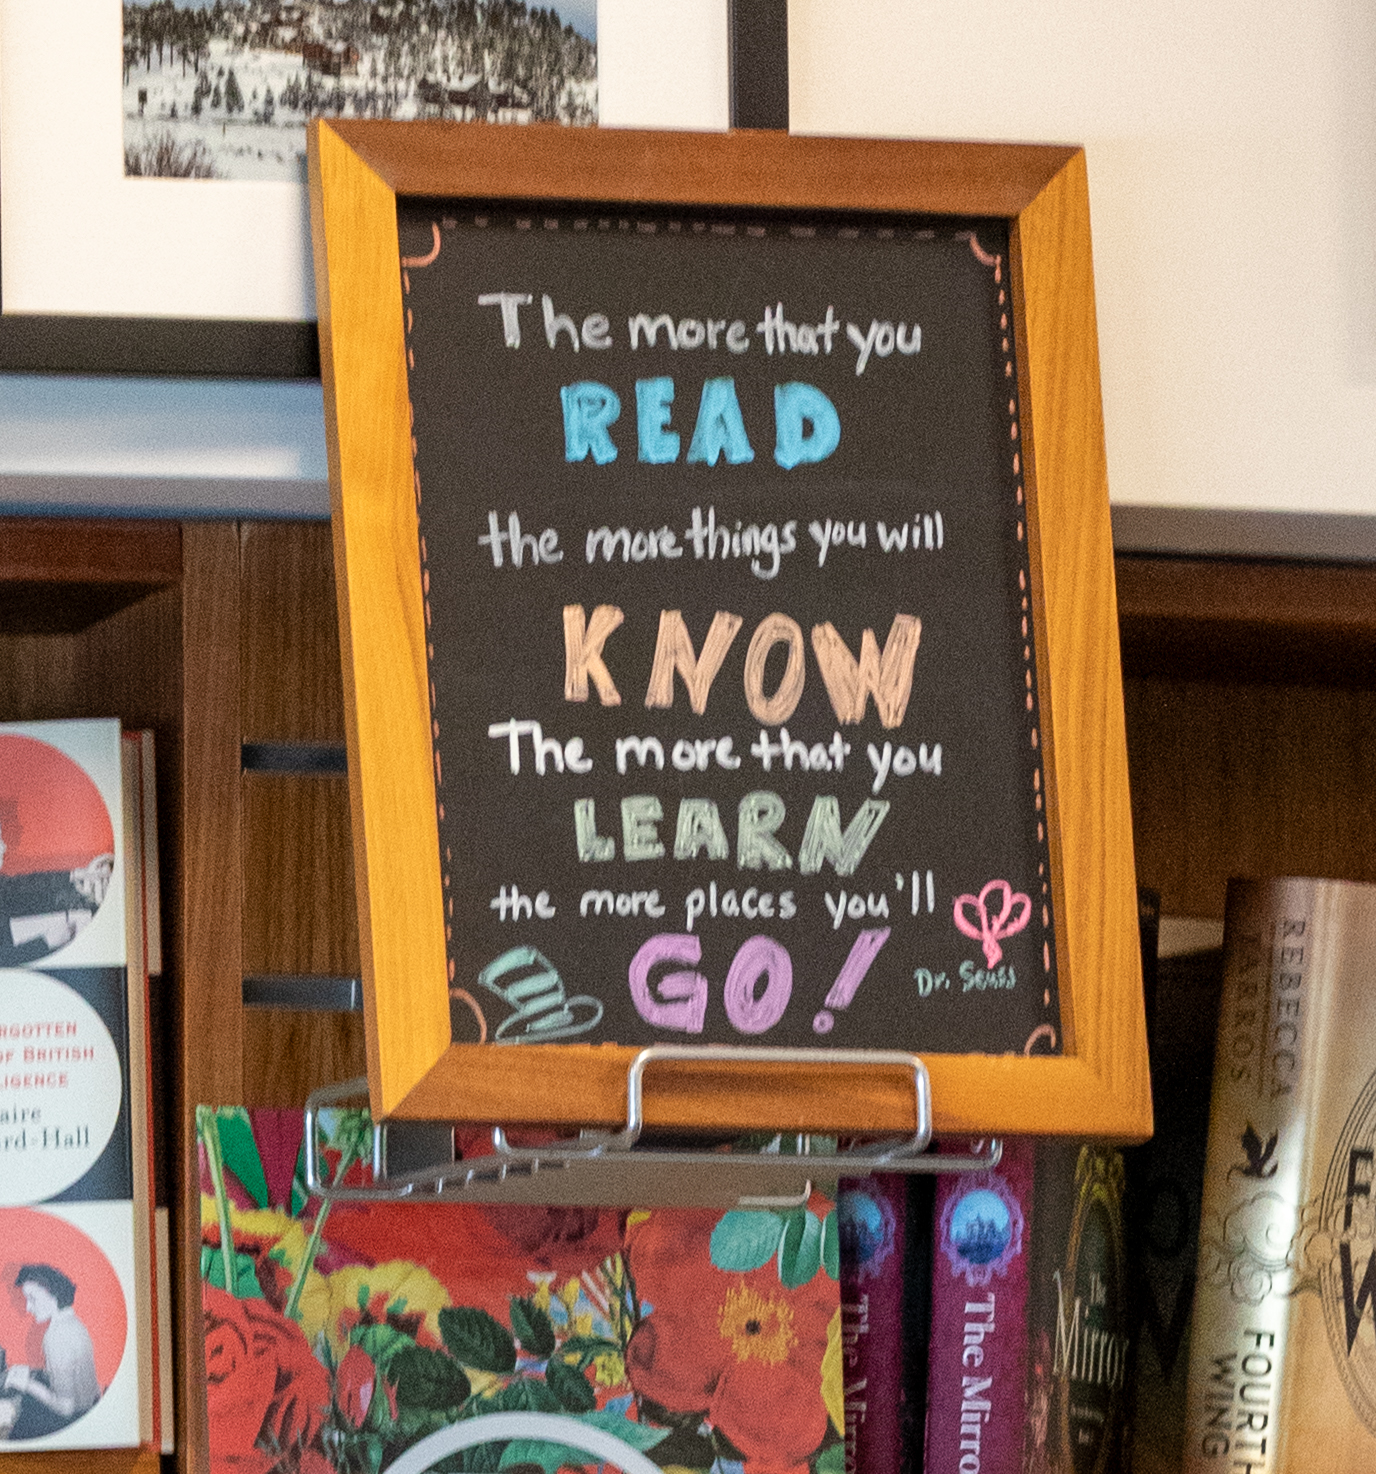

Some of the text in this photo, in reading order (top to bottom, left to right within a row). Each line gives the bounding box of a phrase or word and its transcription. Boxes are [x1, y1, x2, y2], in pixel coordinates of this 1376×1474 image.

[478, 293, 921, 375] The more that you
[561, 377, 841, 469] READ
[478, 507, 944, 579] the more things you will
[563, 604, 922, 729] KNOW
[489, 719, 942, 794] The more that you
[573, 793, 890, 876] LEARN
[491, 871, 935, 930] the more places you'll
[628, 927, 891, 1034] GO!
[915, 964, 1016, 996] Dr. Seuss
[23, 1044, 95, 1063] BRITISH
[962, 1293, 996, 1369] The
[1203, 1354, 1237, 1460] WING
